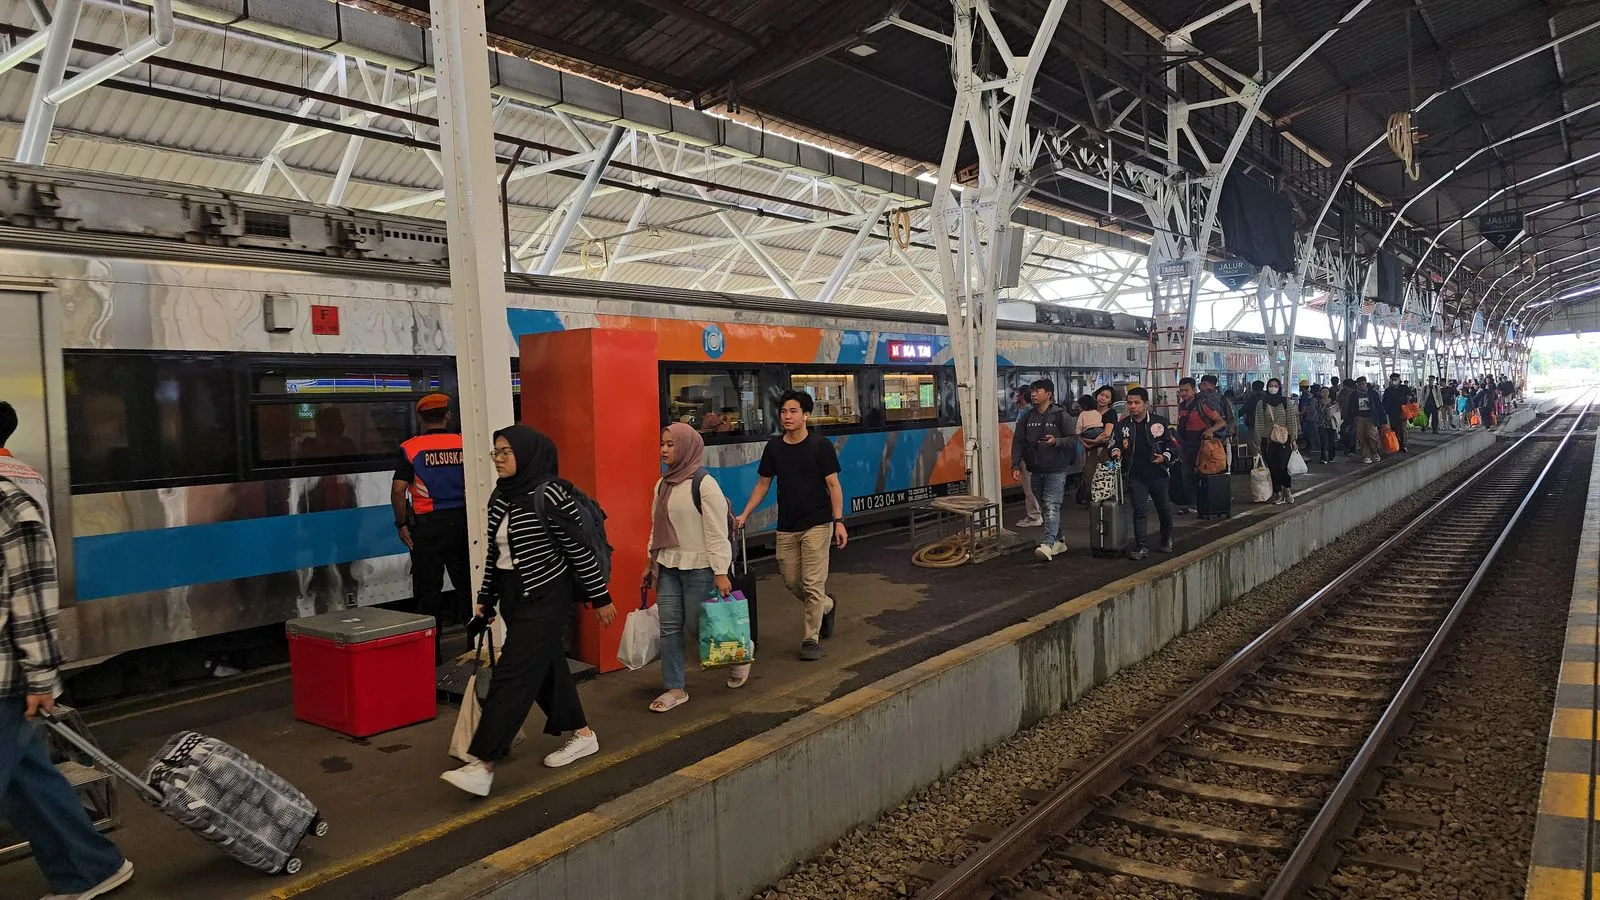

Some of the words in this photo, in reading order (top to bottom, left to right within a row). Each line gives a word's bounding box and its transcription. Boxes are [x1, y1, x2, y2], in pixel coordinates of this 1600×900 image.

[1486, 215, 1517, 225] JALUR
[1498, 234, 1506, 243] 2
[1219, 262, 1243, 270] JALUR
[321, 309, 329, 319] F
[853, 499, 865, 511] M1
[867, 497, 873, 508] 0
[875, 495, 884, 508] 23
[885, 493, 895, 506] 04
